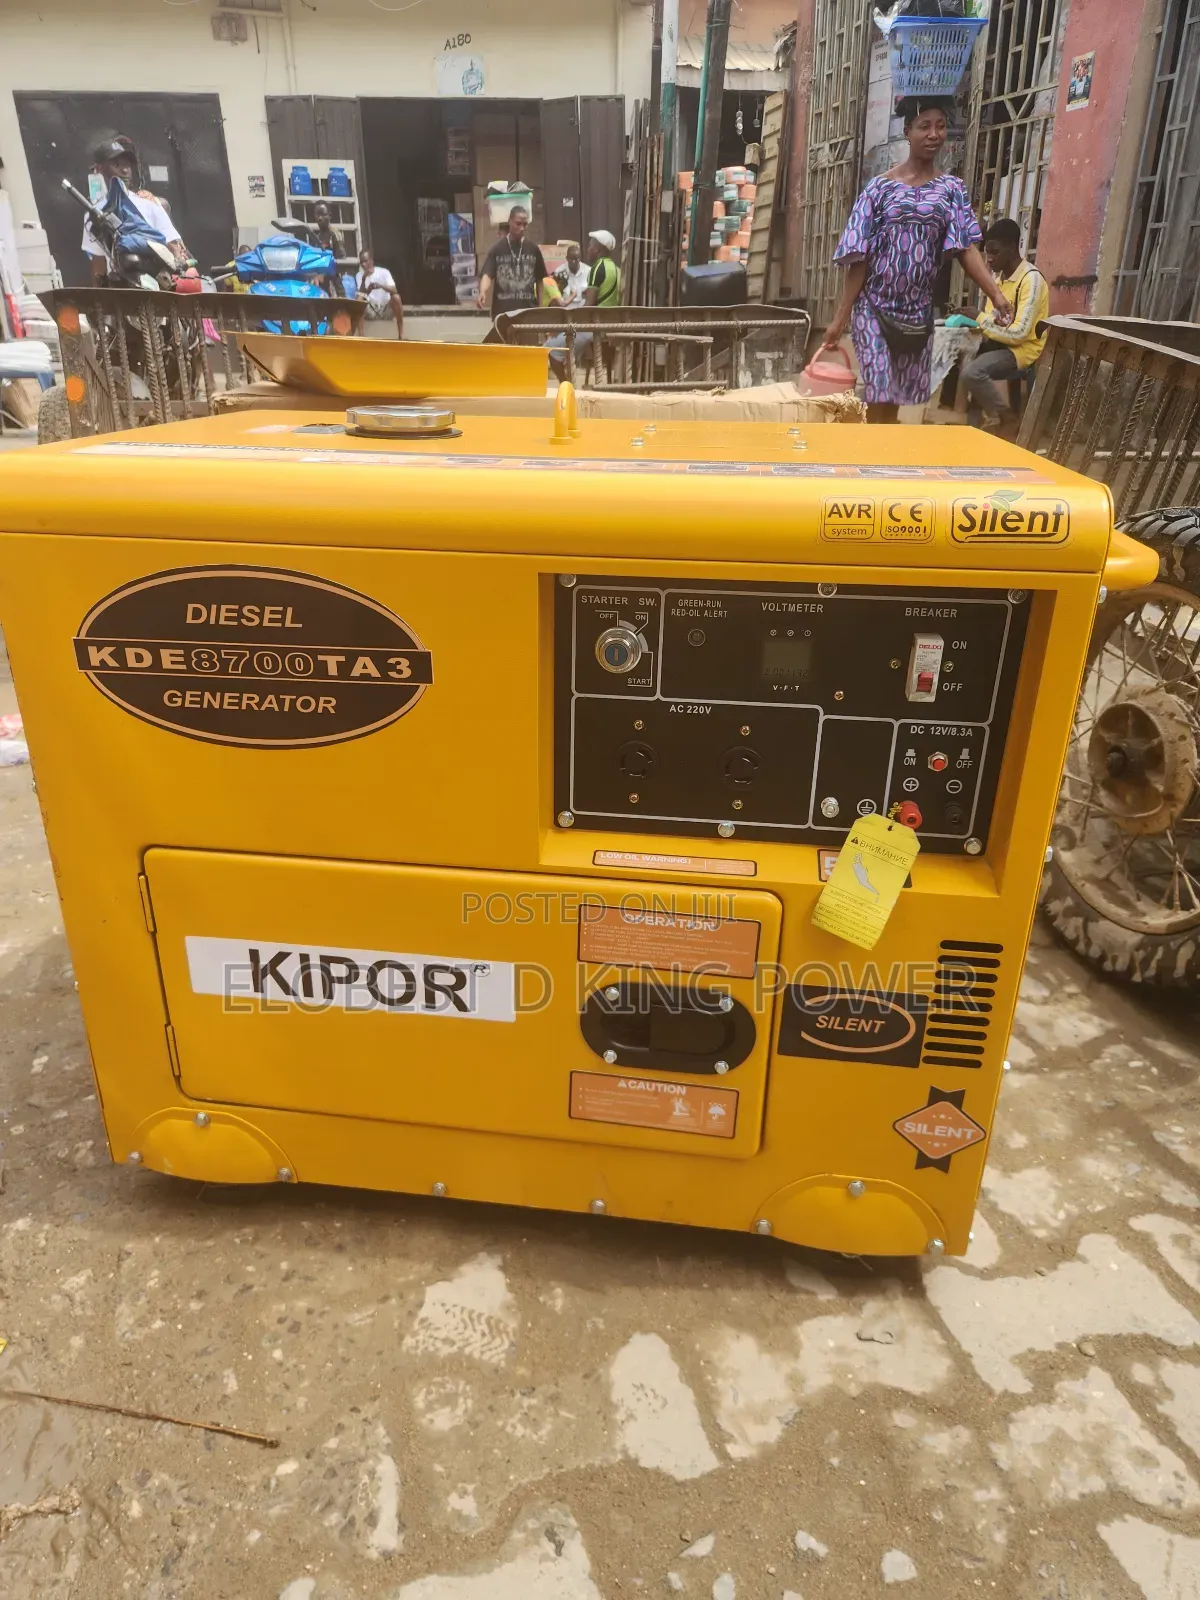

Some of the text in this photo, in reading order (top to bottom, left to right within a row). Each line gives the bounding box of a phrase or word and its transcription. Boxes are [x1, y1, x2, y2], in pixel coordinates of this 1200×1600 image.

[444, 33, 472, 51] A180
[828, 503, 872, 519] AVR
[957, 503, 1065, 534] Silent
[831, 526, 867, 537] system
[885, 525, 927, 534] ISO9001
[581, 595, 657, 607] STARTER SW.
[678, 598, 722, 608] GREEN-RUN
[671, 608, 728, 618] RED-OIL ALERT
[761, 602, 824, 613] VOLTMETER
[905, 607, 958, 618] BREAKER
[185, 603, 303, 629] DIESEL
[951, 640, 967, 650] ON
[87, 645, 413, 679] KDE8700TA3
[942, 682, 963, 692] OFF
[163, 689, 337, 715] GENERATOR
[669, 704, 712, 715] AC 220V
[910, 725, 973, 737] DC 12V/8.3A
[903, 757, 916, 766] ON
[956, 760, 973, 769] OFF
[600, 852, 623, 860] LOW
[624, 853, 640, 861] OIL
[860, 840, 909, 866] ВНИМАНИЕ
[623, 912, 717, 932] OPERATION
[248, 948, 471, 1013] KIPOR
[816, 1014, 886, 1034] SILENT
[628, 1079, 687, 1095] CAUTION
[903, 1121, 977, 1140] SILENT
